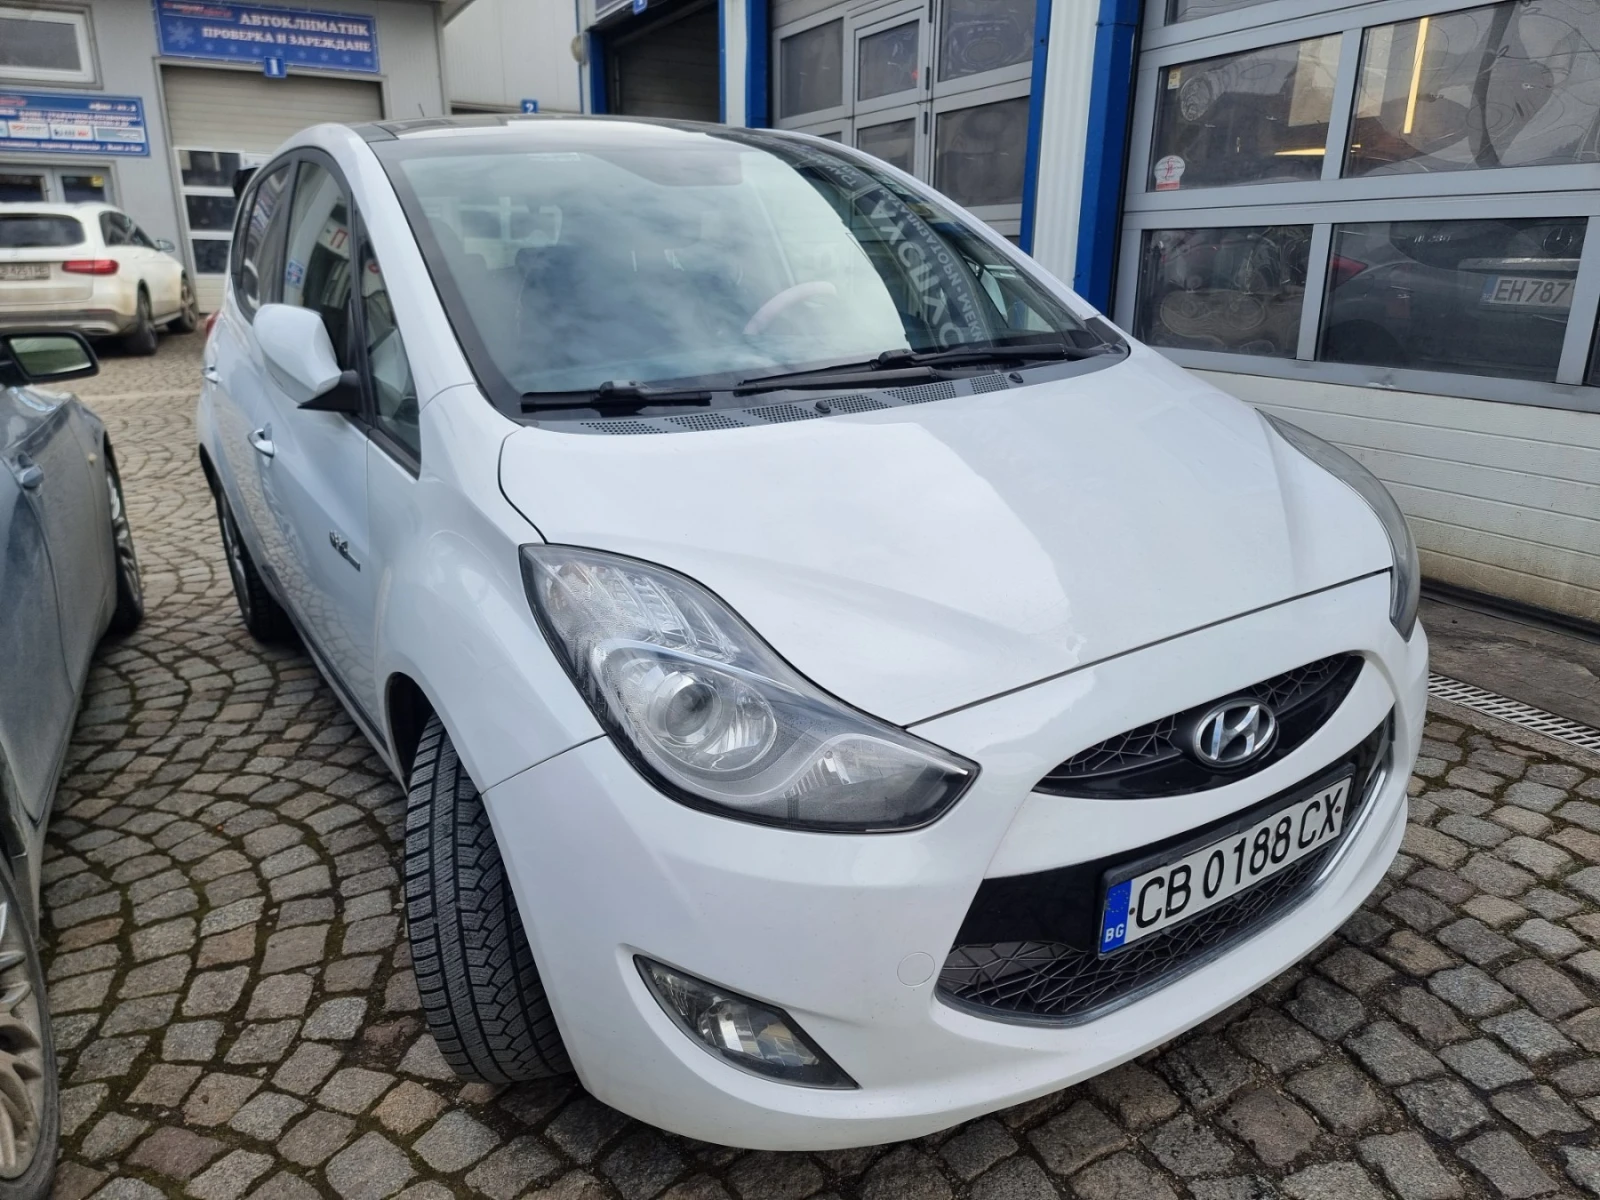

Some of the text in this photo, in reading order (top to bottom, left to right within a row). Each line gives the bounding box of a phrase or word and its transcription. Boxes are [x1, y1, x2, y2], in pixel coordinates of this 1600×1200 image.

[239, 13, 369, 37] АВТОКЛИМАТИК
[202, 27, 371, 52] ПРОВЕРКА И ЗАРЕЖДАНЕ
[269, 58, 280, 75] 1
[1135, 787, 1343, 929] CB 0188 CX
[1105, 923, 1125, 944] BG
